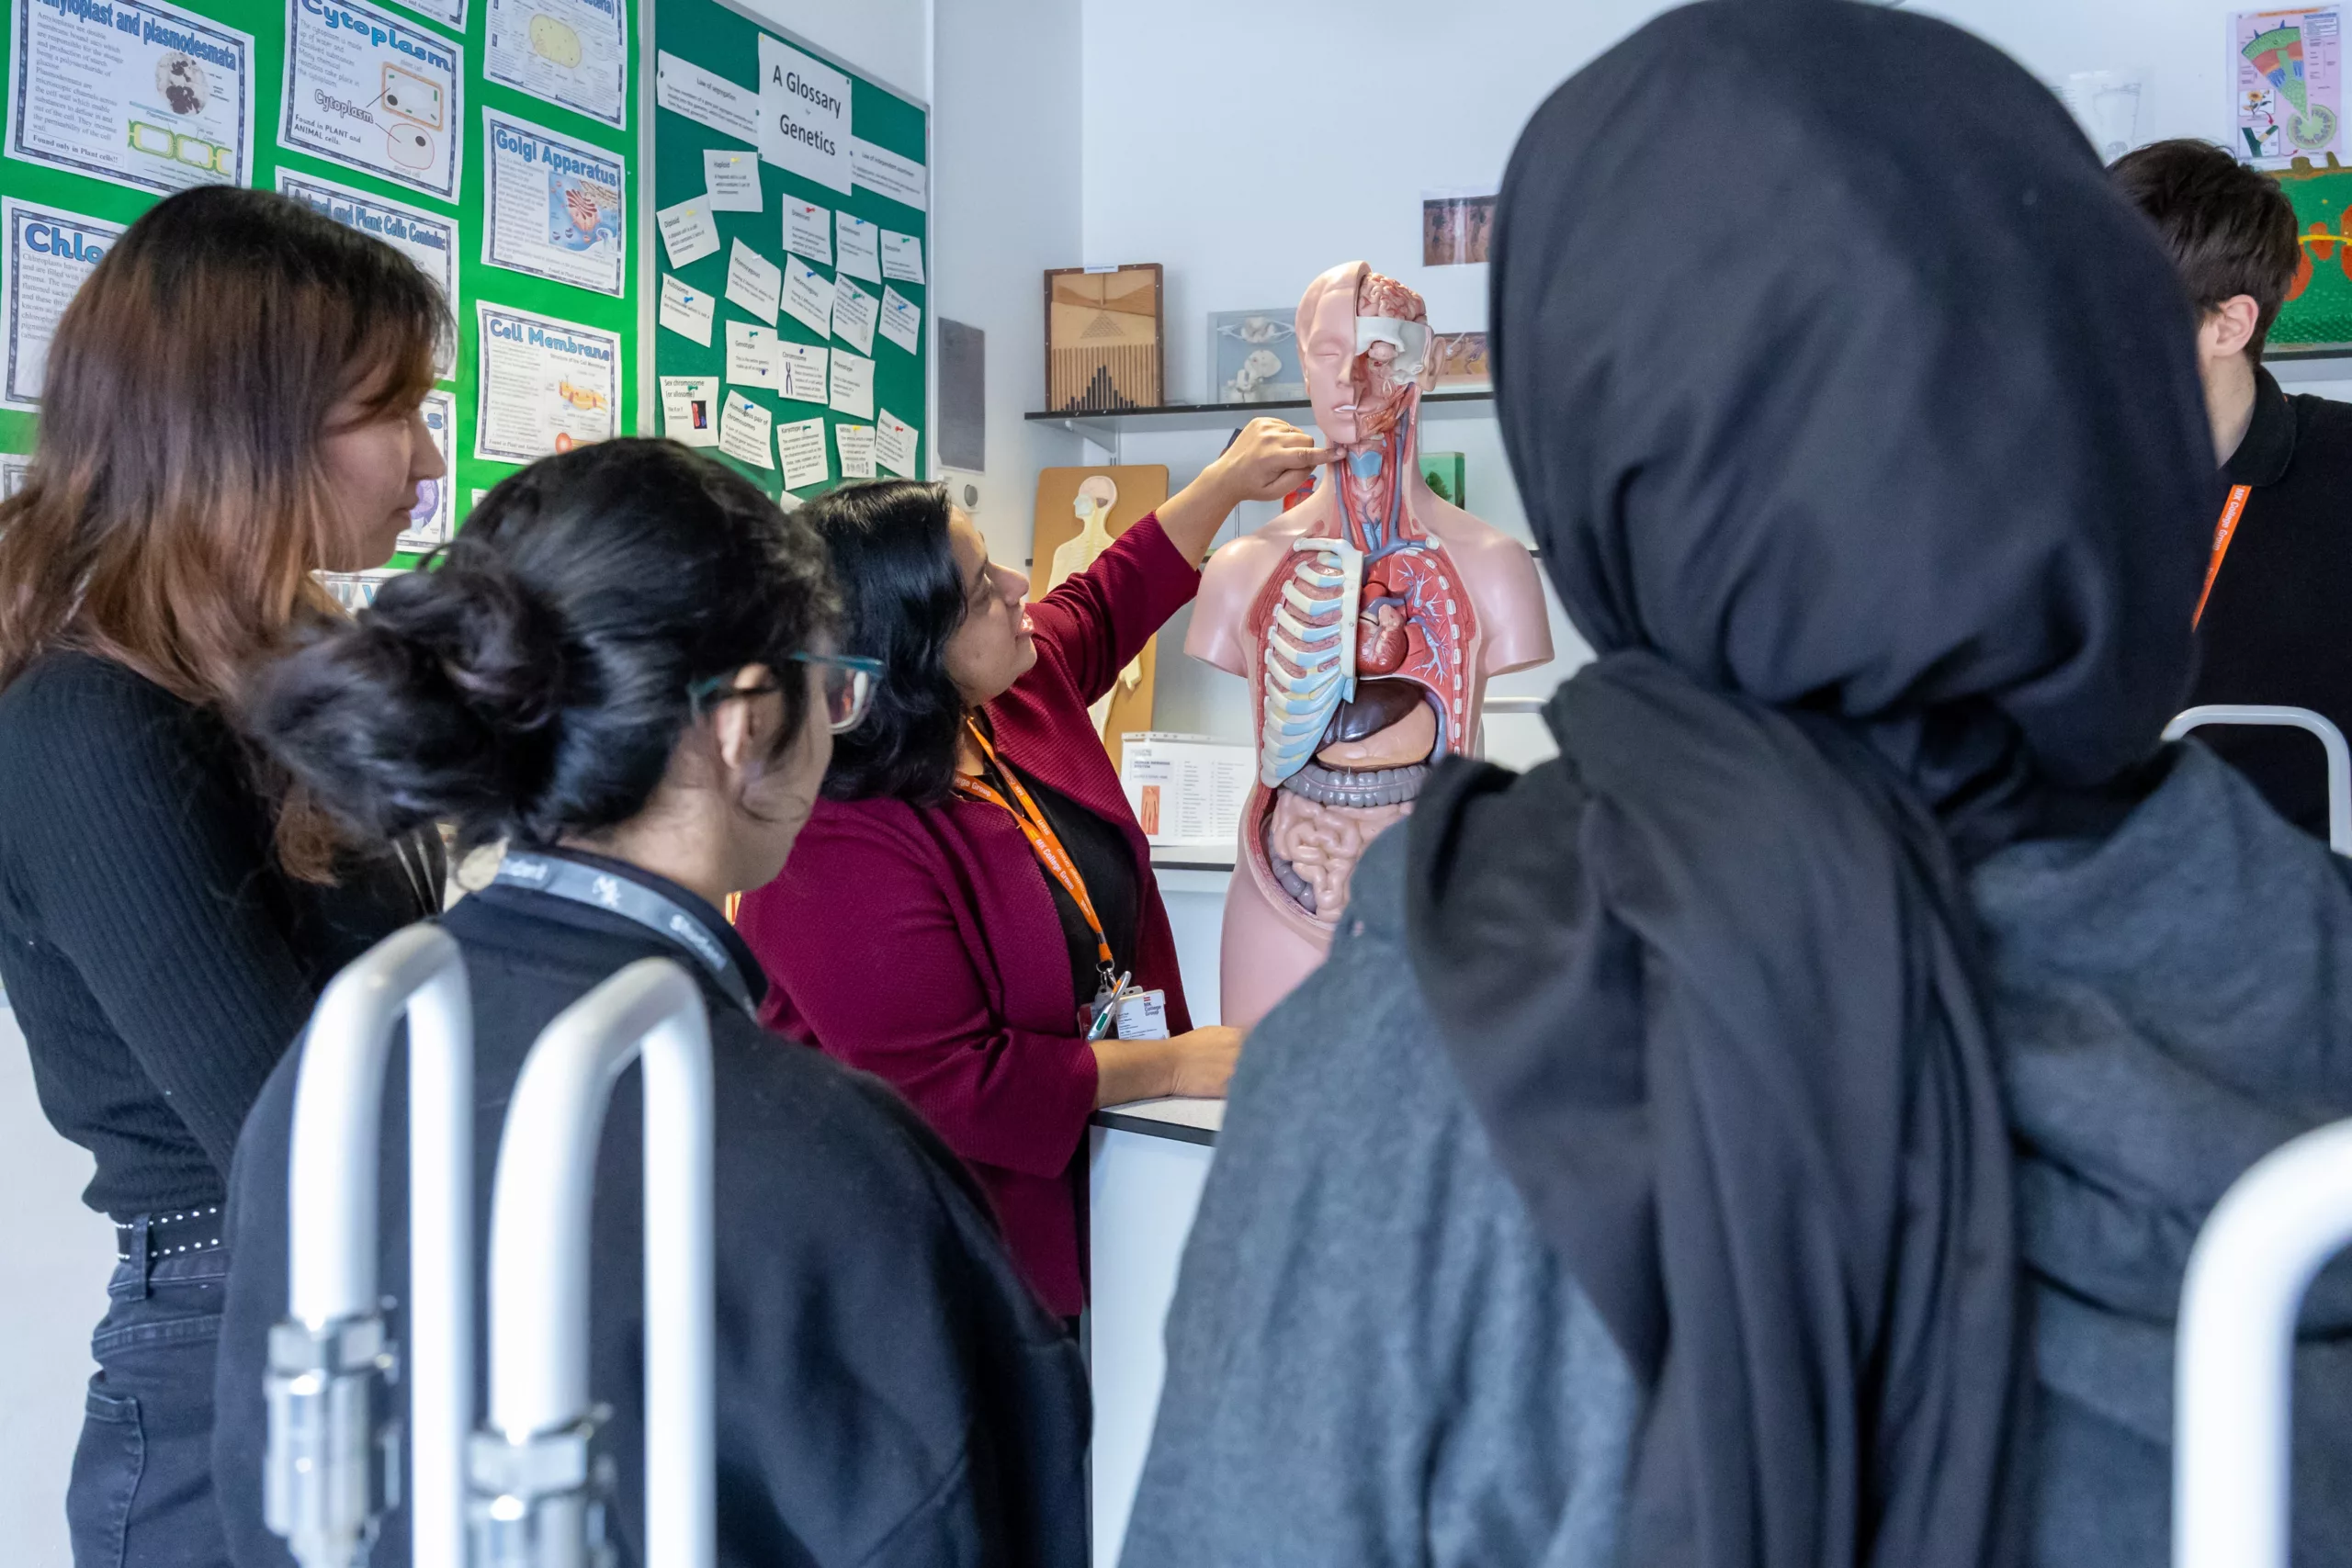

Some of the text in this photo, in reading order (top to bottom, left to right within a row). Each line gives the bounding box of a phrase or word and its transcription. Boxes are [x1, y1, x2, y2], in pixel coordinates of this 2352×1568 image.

[35, 0, 236, 71] yloplast and plasmodesmata
[301, 0, 451, 73] Cytoplasm
[314, 89, 374, 124] Cytoplasm
[773, 65, 783, 86] A
[786, 72, 841, 118] Glossary
[295, 114, 315, 127] Found
[325, 125, 348, 139] PLANT
[350, 135, 360, 143] and
[295, 123, 322, 140] ANIMAL
[780, 115, 836, 156] Genetics
[33, 135, 54, 146] Found
[56, 141, 70, 152] only
[81, 148, 98, 159] Plant
[496, 130, 616, 186] Golgi Apparatus
[356, 207, 382, 231] Plant
[384, 215, 407, 239] Cells
[664, 217, 680, 228] Diploid
[25, 223, 104, 265] Chlo
[490, 319, 524, 343] Cell
[528, 327, 610, 362] Membrane
[2233, 488, 2245, 502] MK
[2222, 502, 2239, 528] College
[972, 782, 991, 797] Group
[1035, 839, 1074, 889] MK College Group
